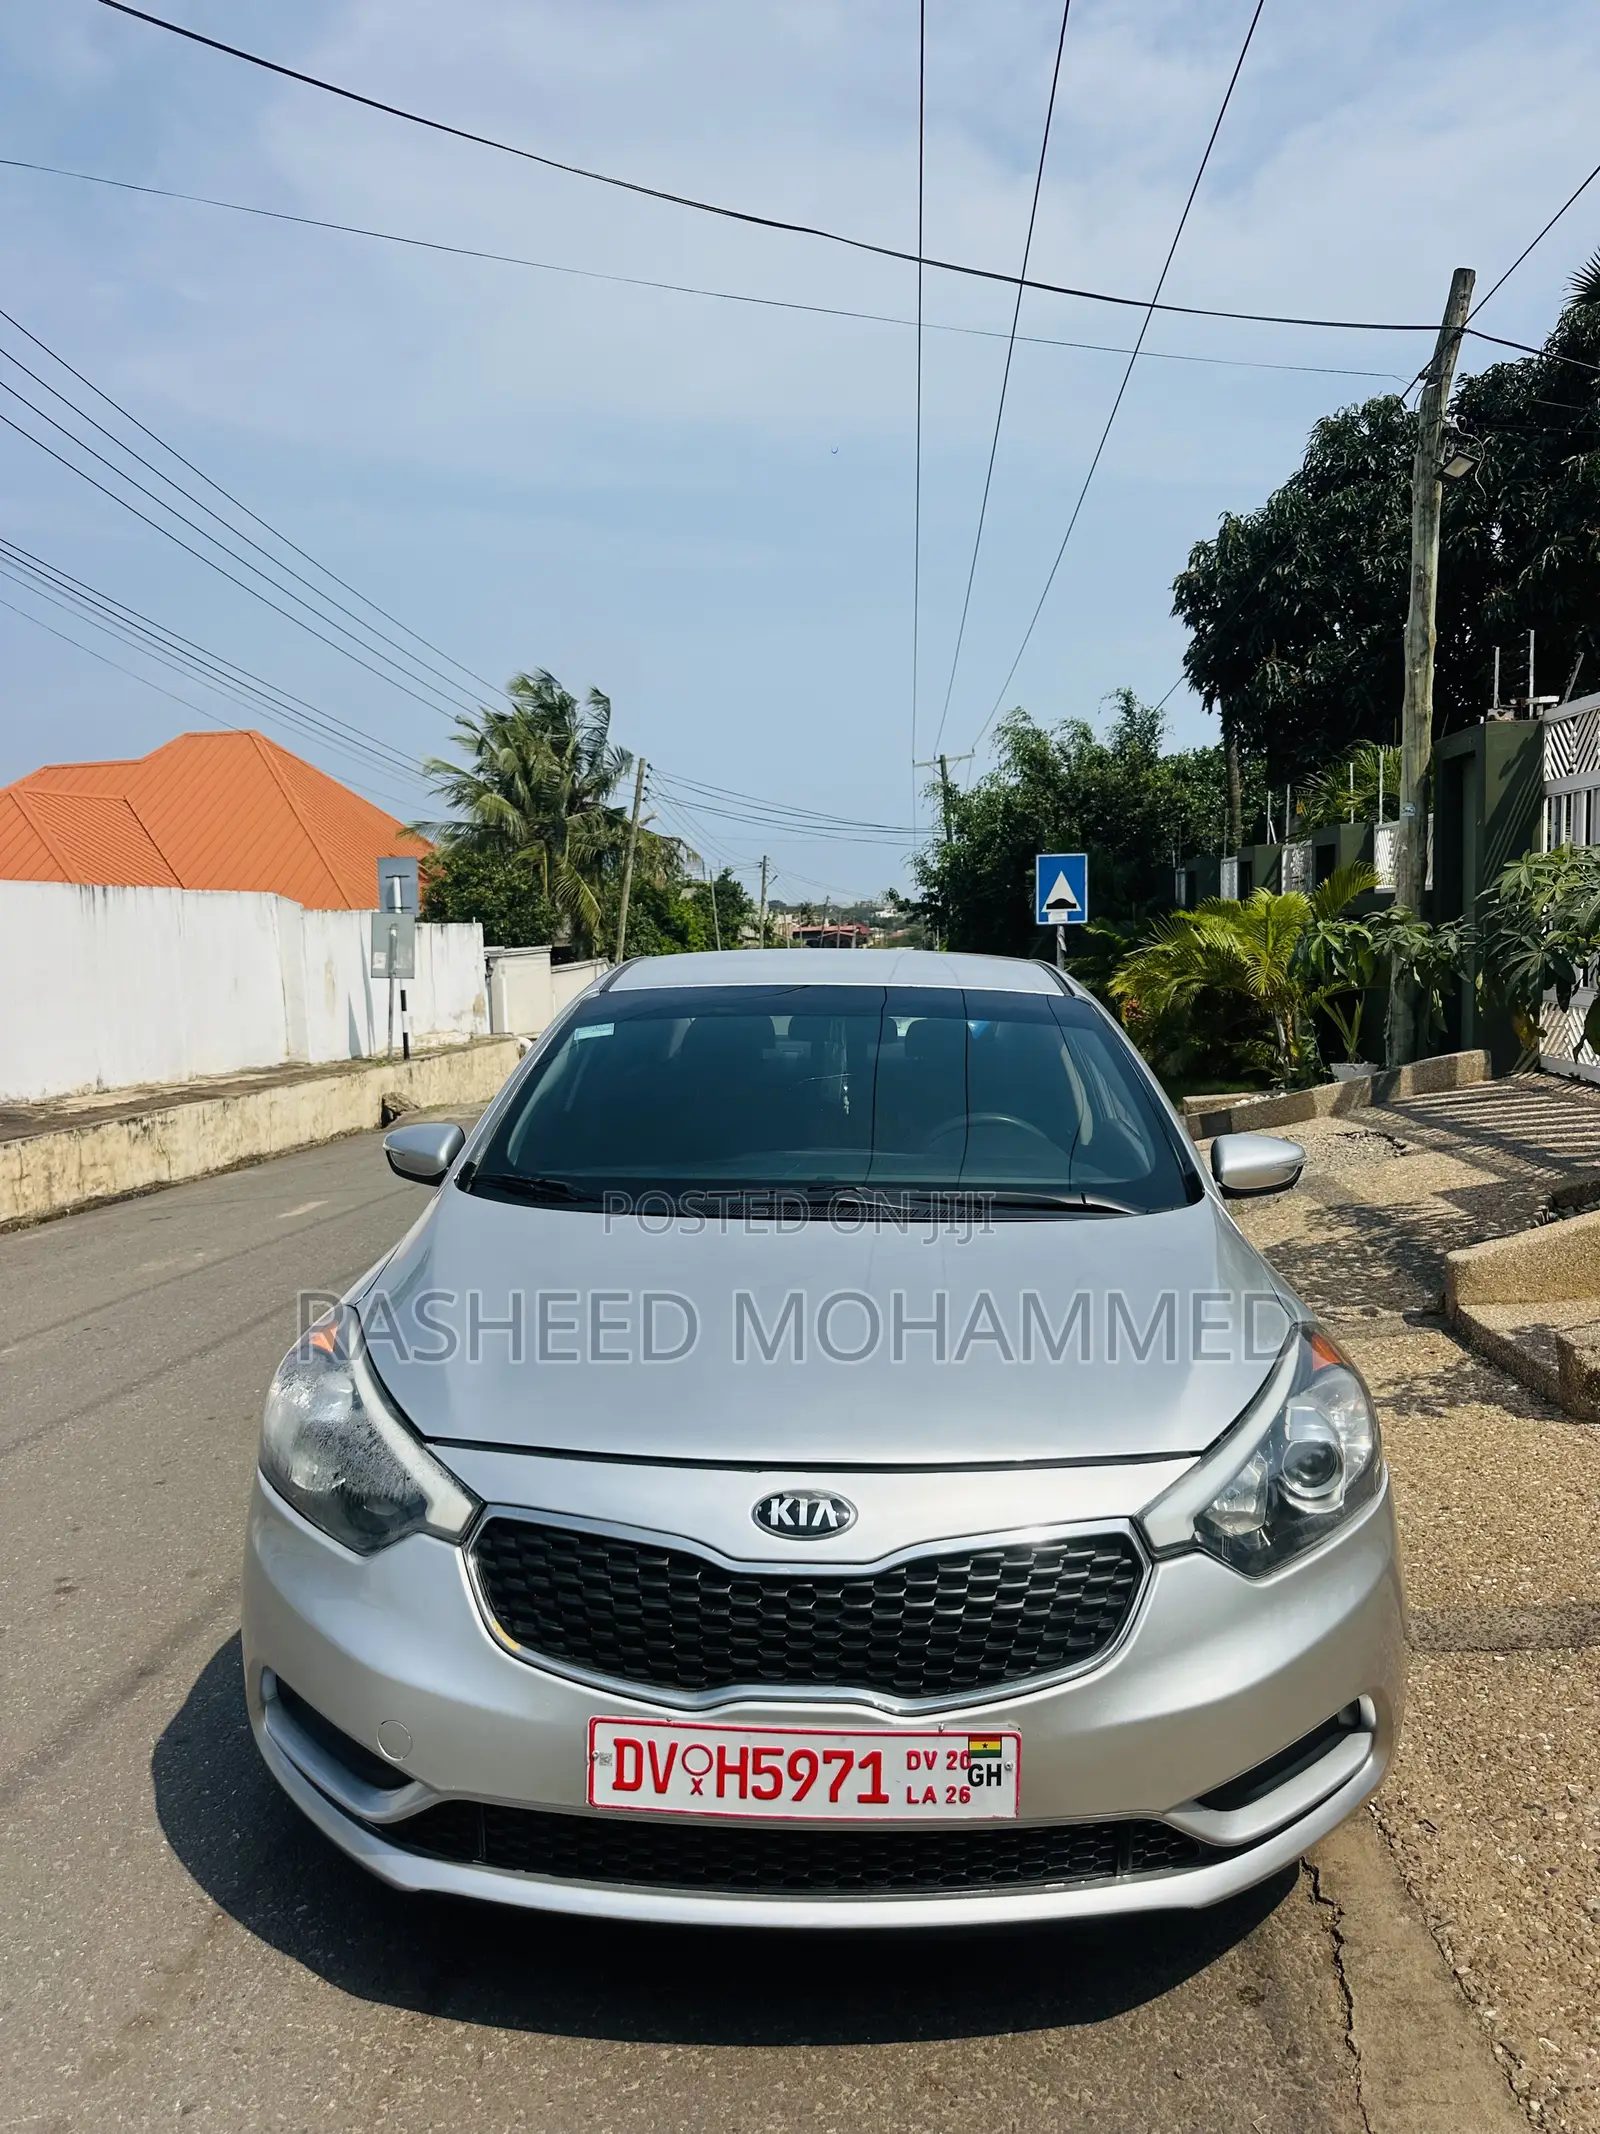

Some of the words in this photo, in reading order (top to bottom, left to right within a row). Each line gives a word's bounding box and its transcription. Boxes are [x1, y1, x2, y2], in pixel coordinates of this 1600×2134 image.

[769, 1497, 839, 1528] KIA
[906, 1750, 938, 1770] DV
[946, 1750, 972, 1770] 20
[967, 1763, 1002, 1788] GH
[906, 1785, 938, 1804] LA
[945, 1785, 971, 1804] 26
